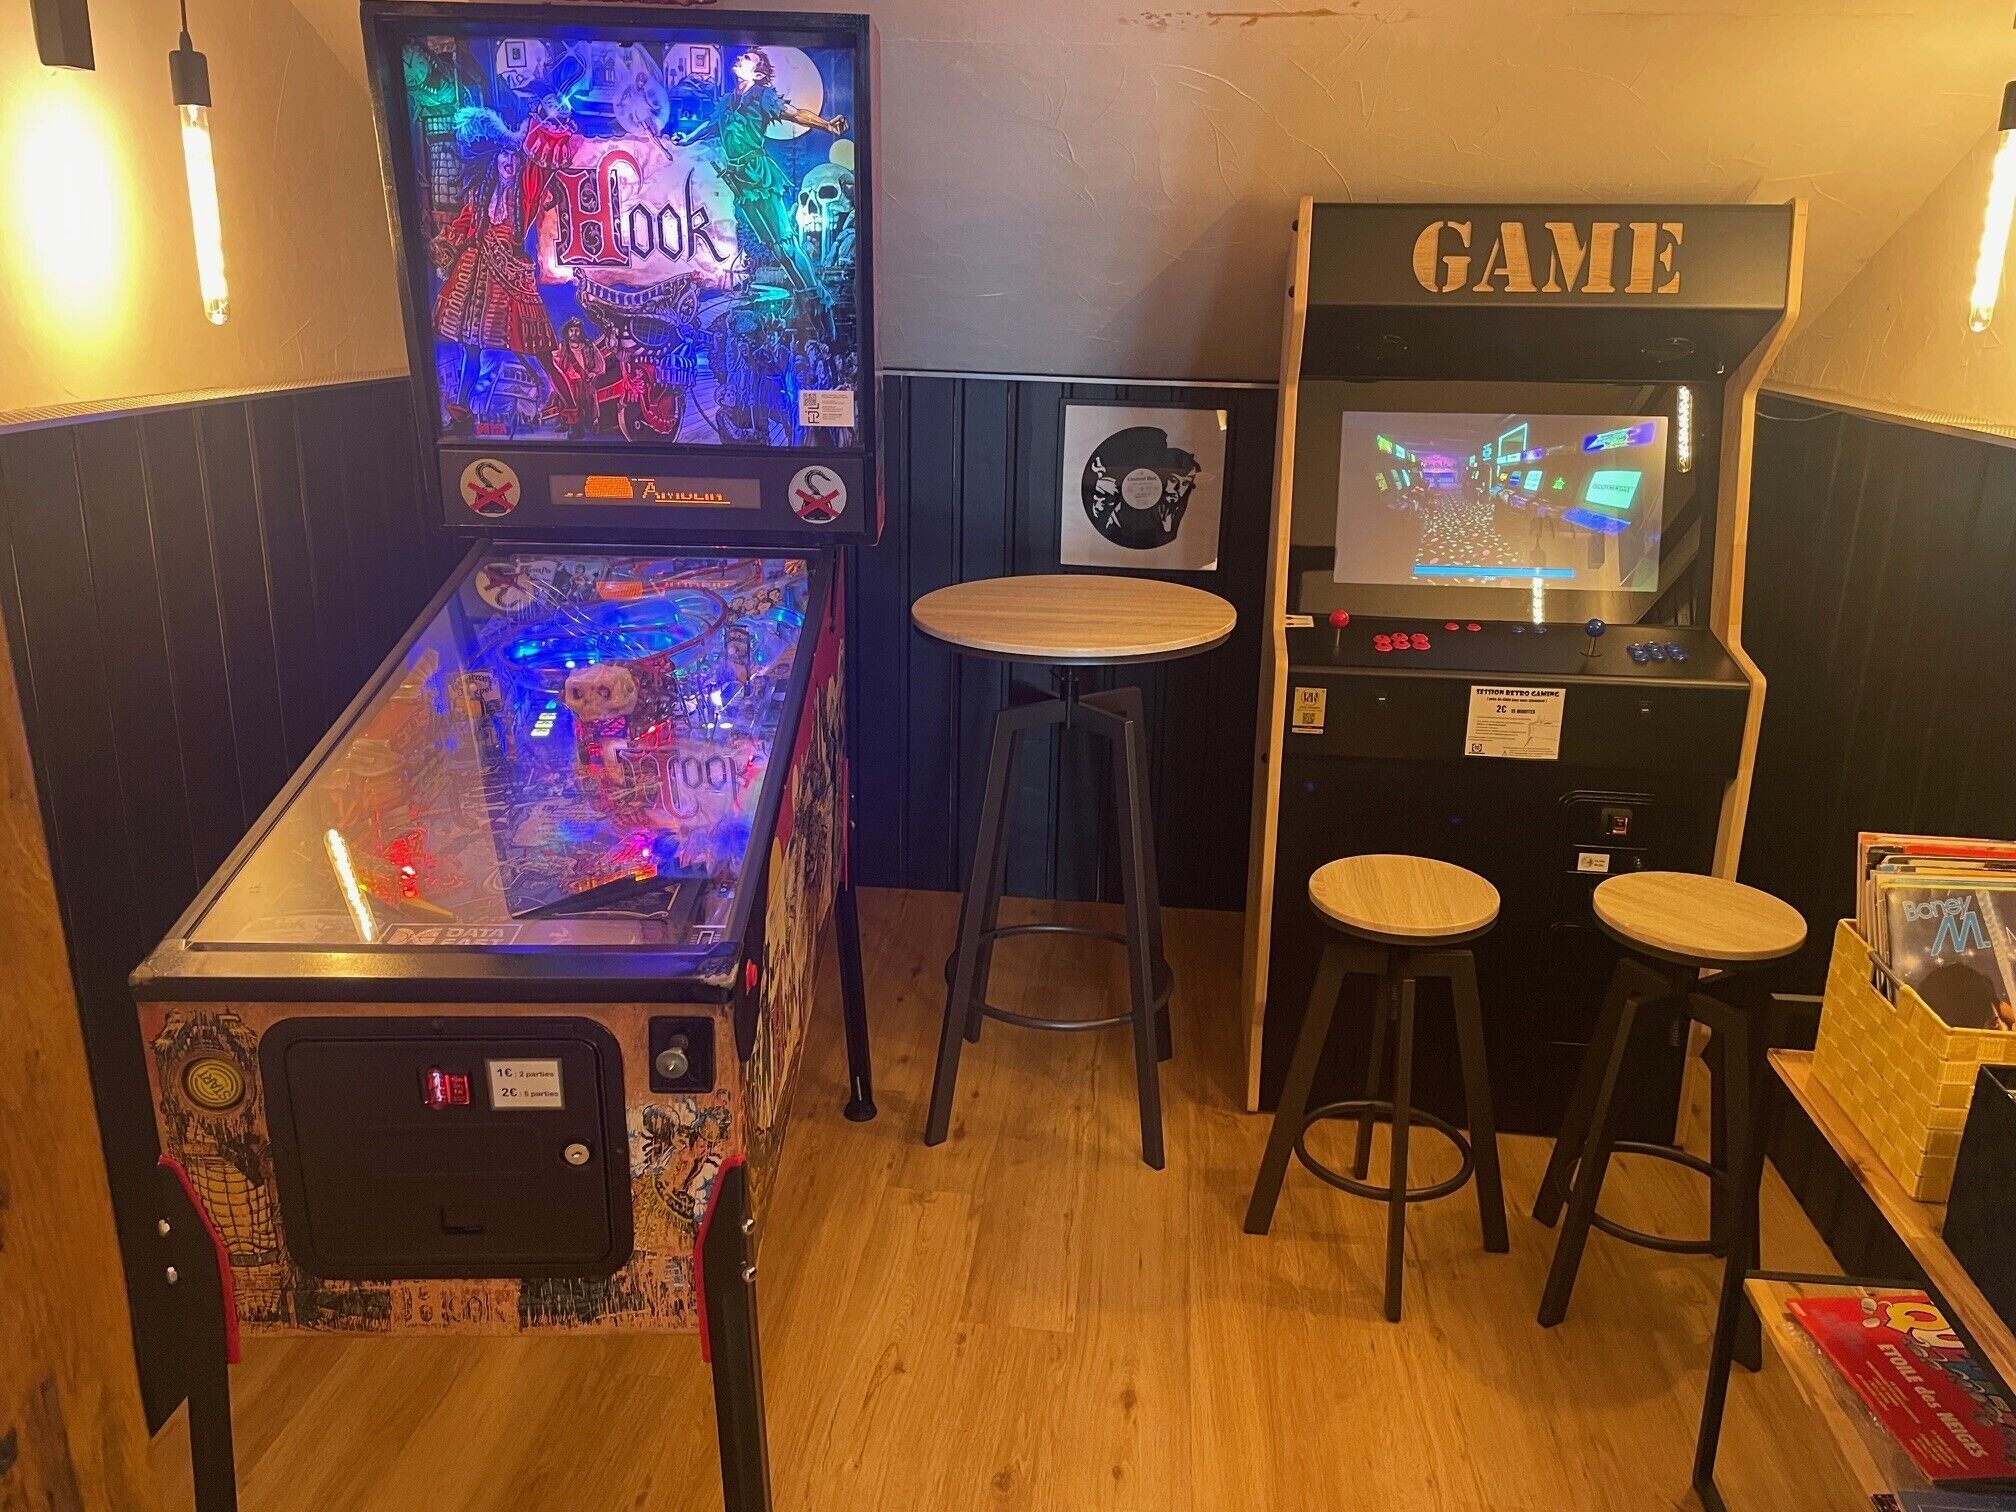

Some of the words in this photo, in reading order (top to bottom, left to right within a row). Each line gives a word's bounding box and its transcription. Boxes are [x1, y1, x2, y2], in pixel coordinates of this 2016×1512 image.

[554, 150, 730, 266] Hook
[1412, 220, 1683, 293] GAME
[1476, 688, 1504, 696] SESSION
[1505, 689, 1530, 697] RETRO
[1531, 690, 1560, 698] GAMING
[1902, 895, 1972, 921] Boney
[447, 928, 504, 938] DATA
[196, 1069, 232, 1100] START
[496, 1068, 513, 1078] 1€
[525, 1071, 554, 1079] parties
[501, 1088, 518, 1098] 2€
[530, 1090, 559, 1098] parties
[1876, 1343, 1924, 1383] ETOILE
[1914, 1386, 1942, 1409] des
[1936, 1412, 1989, 1458] NEIGES
